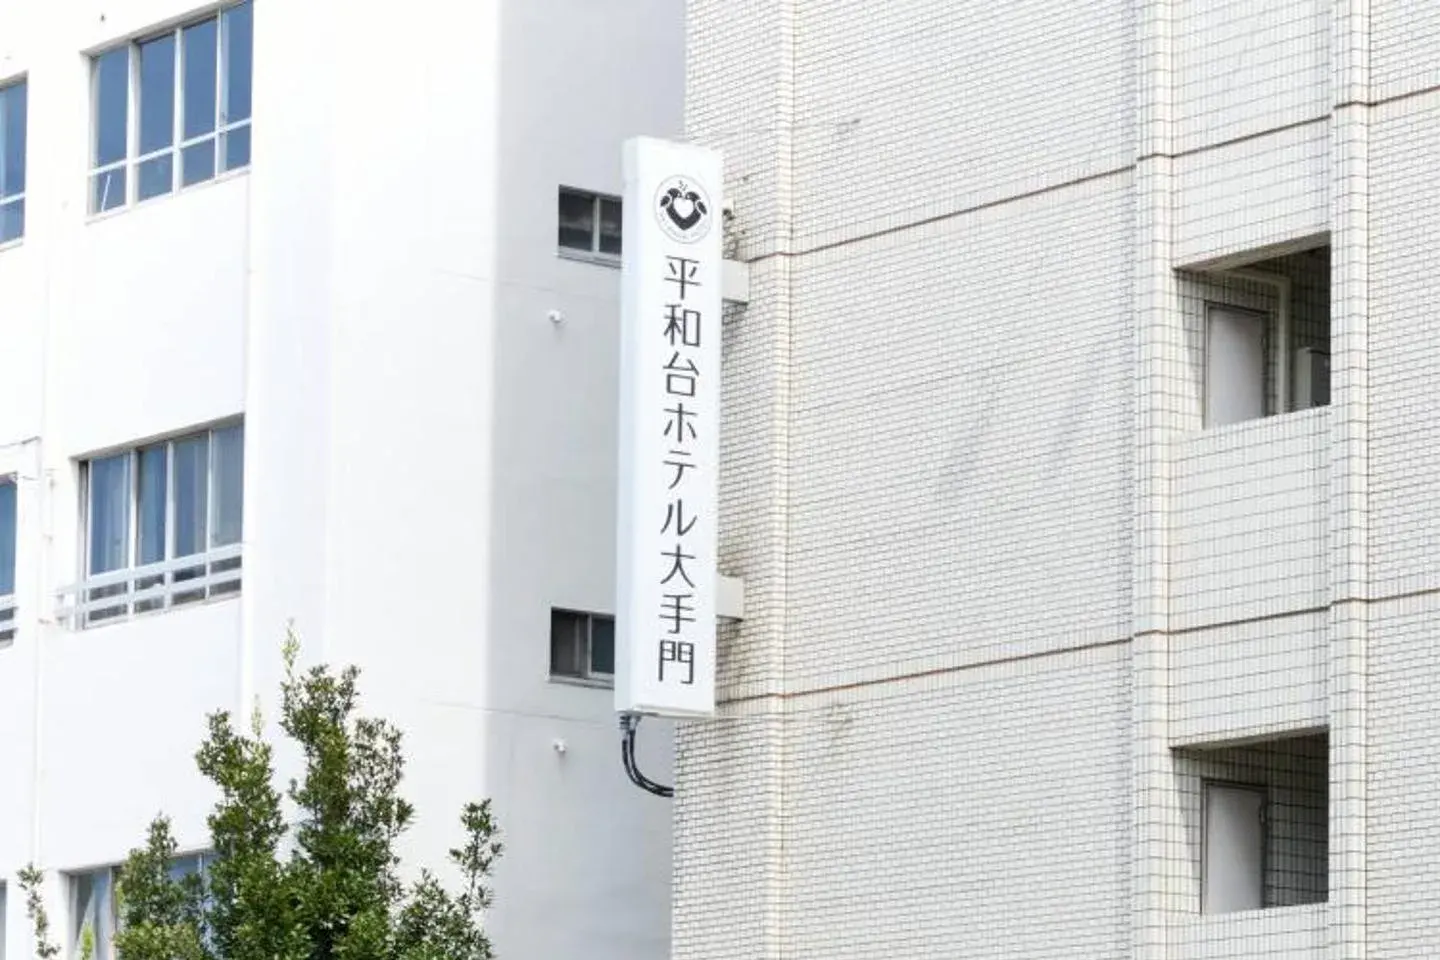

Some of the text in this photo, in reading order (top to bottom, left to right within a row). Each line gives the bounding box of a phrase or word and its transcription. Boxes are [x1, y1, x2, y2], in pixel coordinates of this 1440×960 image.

[657, 254, 702, 686] 平和台ホテル大手門
